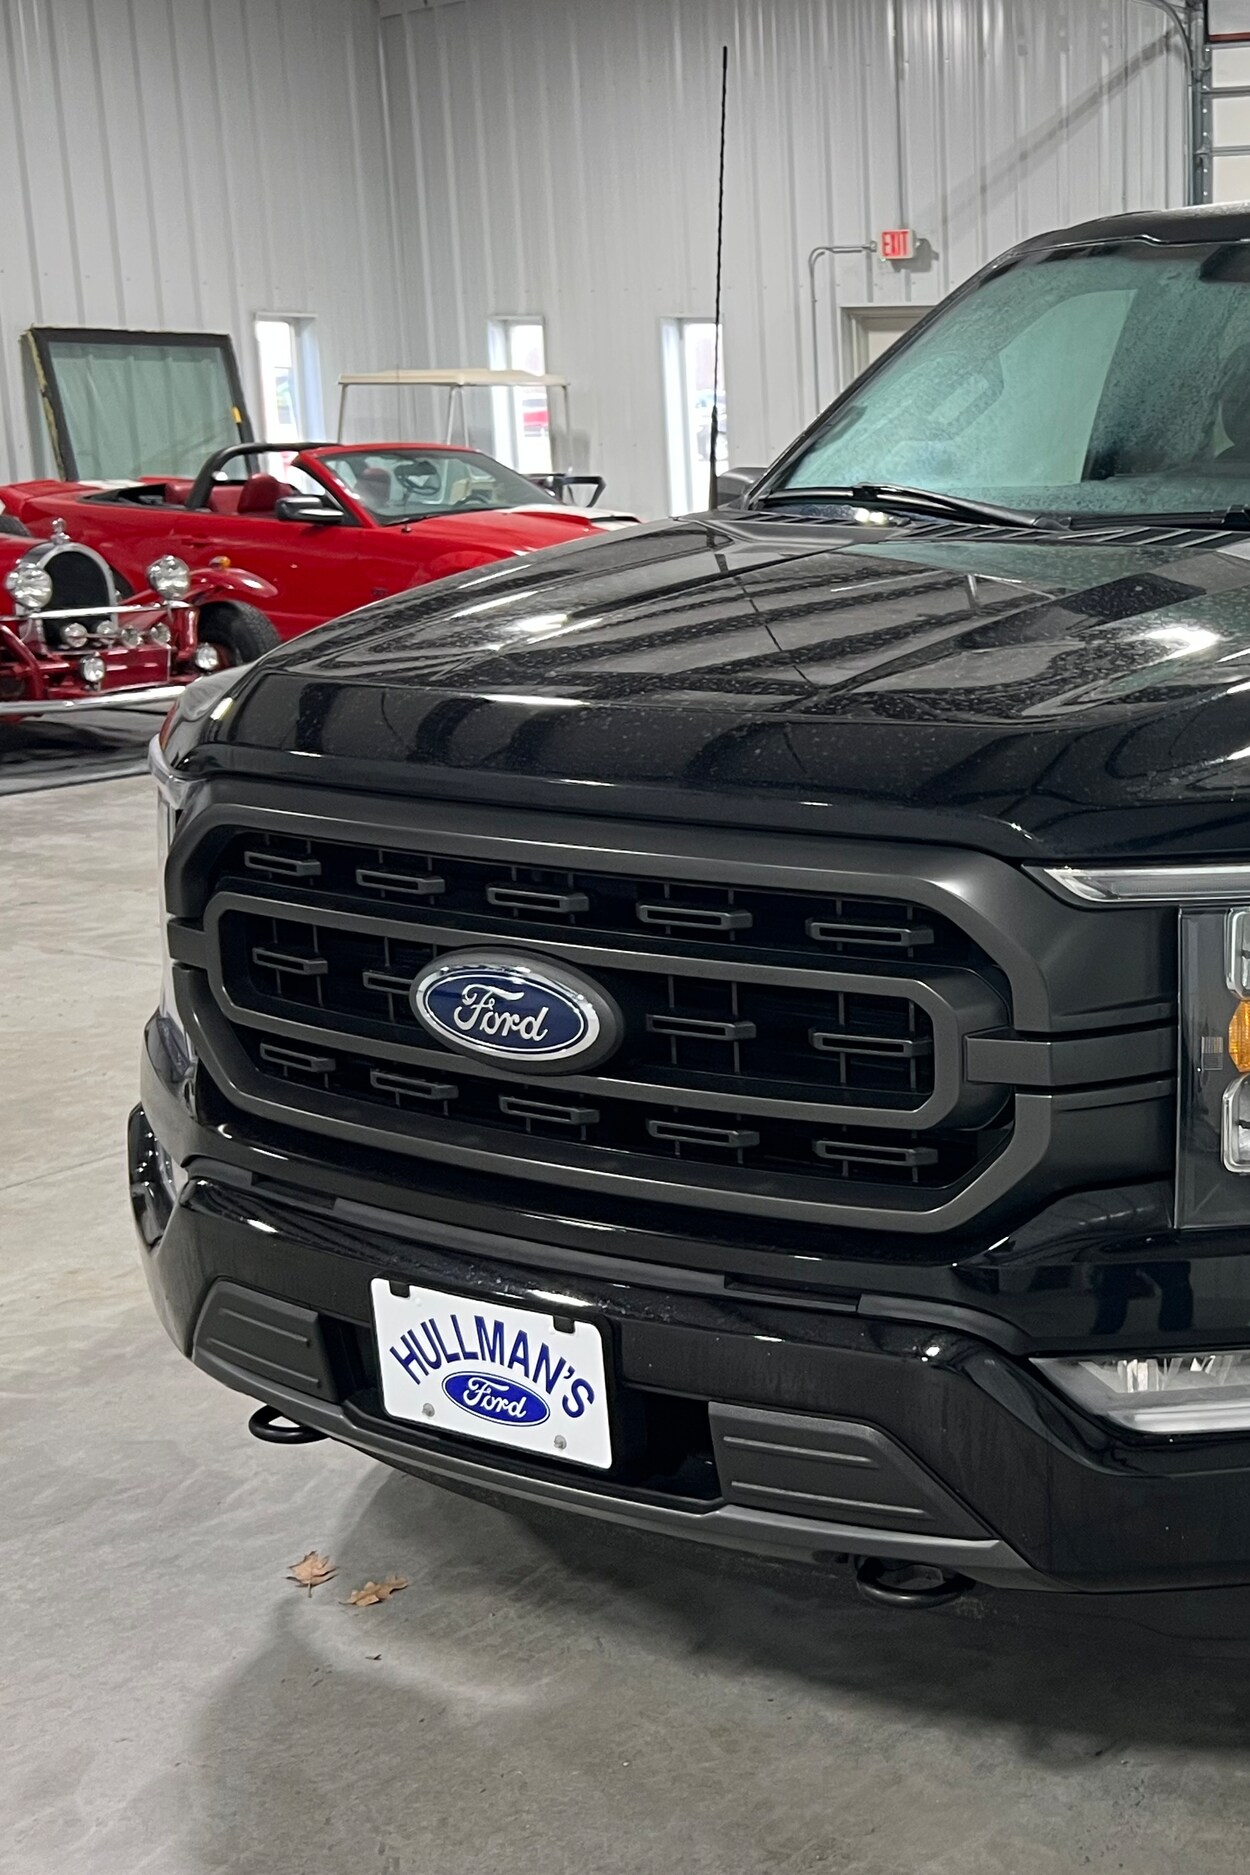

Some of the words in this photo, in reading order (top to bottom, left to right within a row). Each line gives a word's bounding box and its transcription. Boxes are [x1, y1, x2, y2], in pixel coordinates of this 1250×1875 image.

[881, 231, 909, 257] EXIT
[453, 983, 550, 1042] Ford
[389, 1314, 595, 1418] HULLMAN'S
[463, 1377, 527, 1419] Ford
